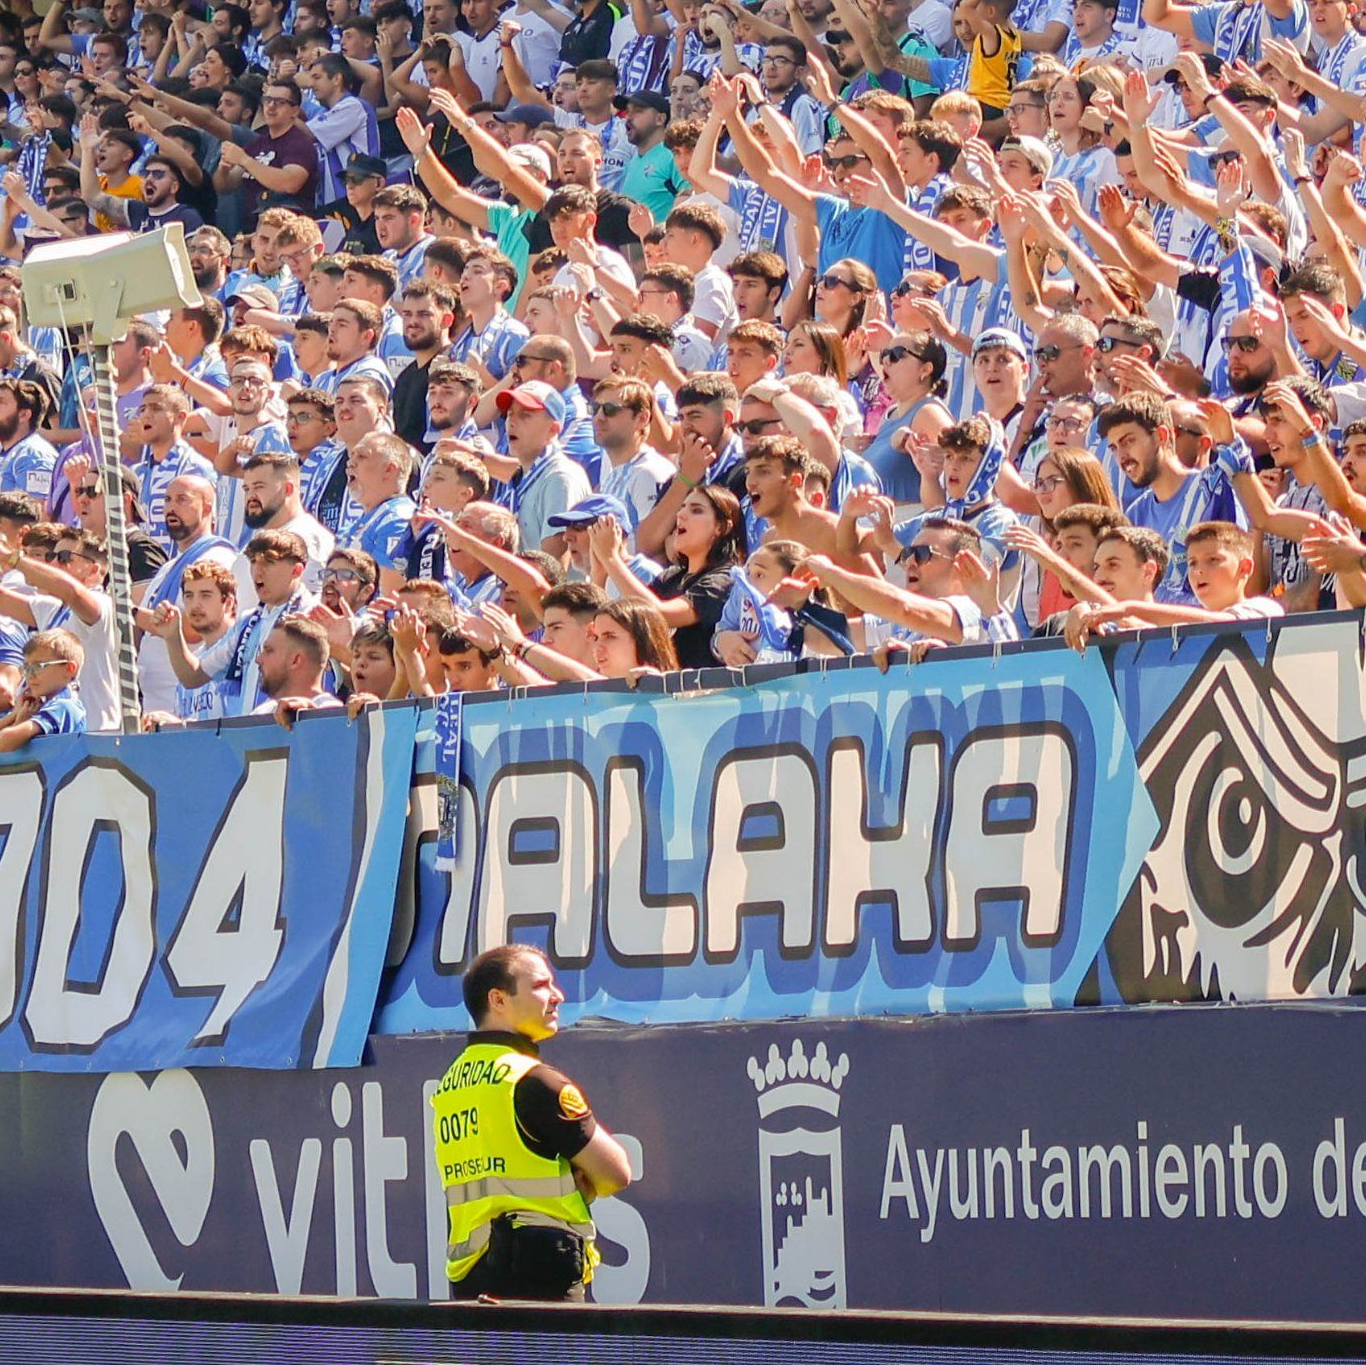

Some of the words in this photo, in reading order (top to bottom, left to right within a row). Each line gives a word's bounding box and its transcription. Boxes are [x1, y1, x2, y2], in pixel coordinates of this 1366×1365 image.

[433, 1058, 512, 1097] EGURIDAD
[440, 1107, 479, 1145] 0079
[880, 1121, 1288, 1242] Ayuntamiento
